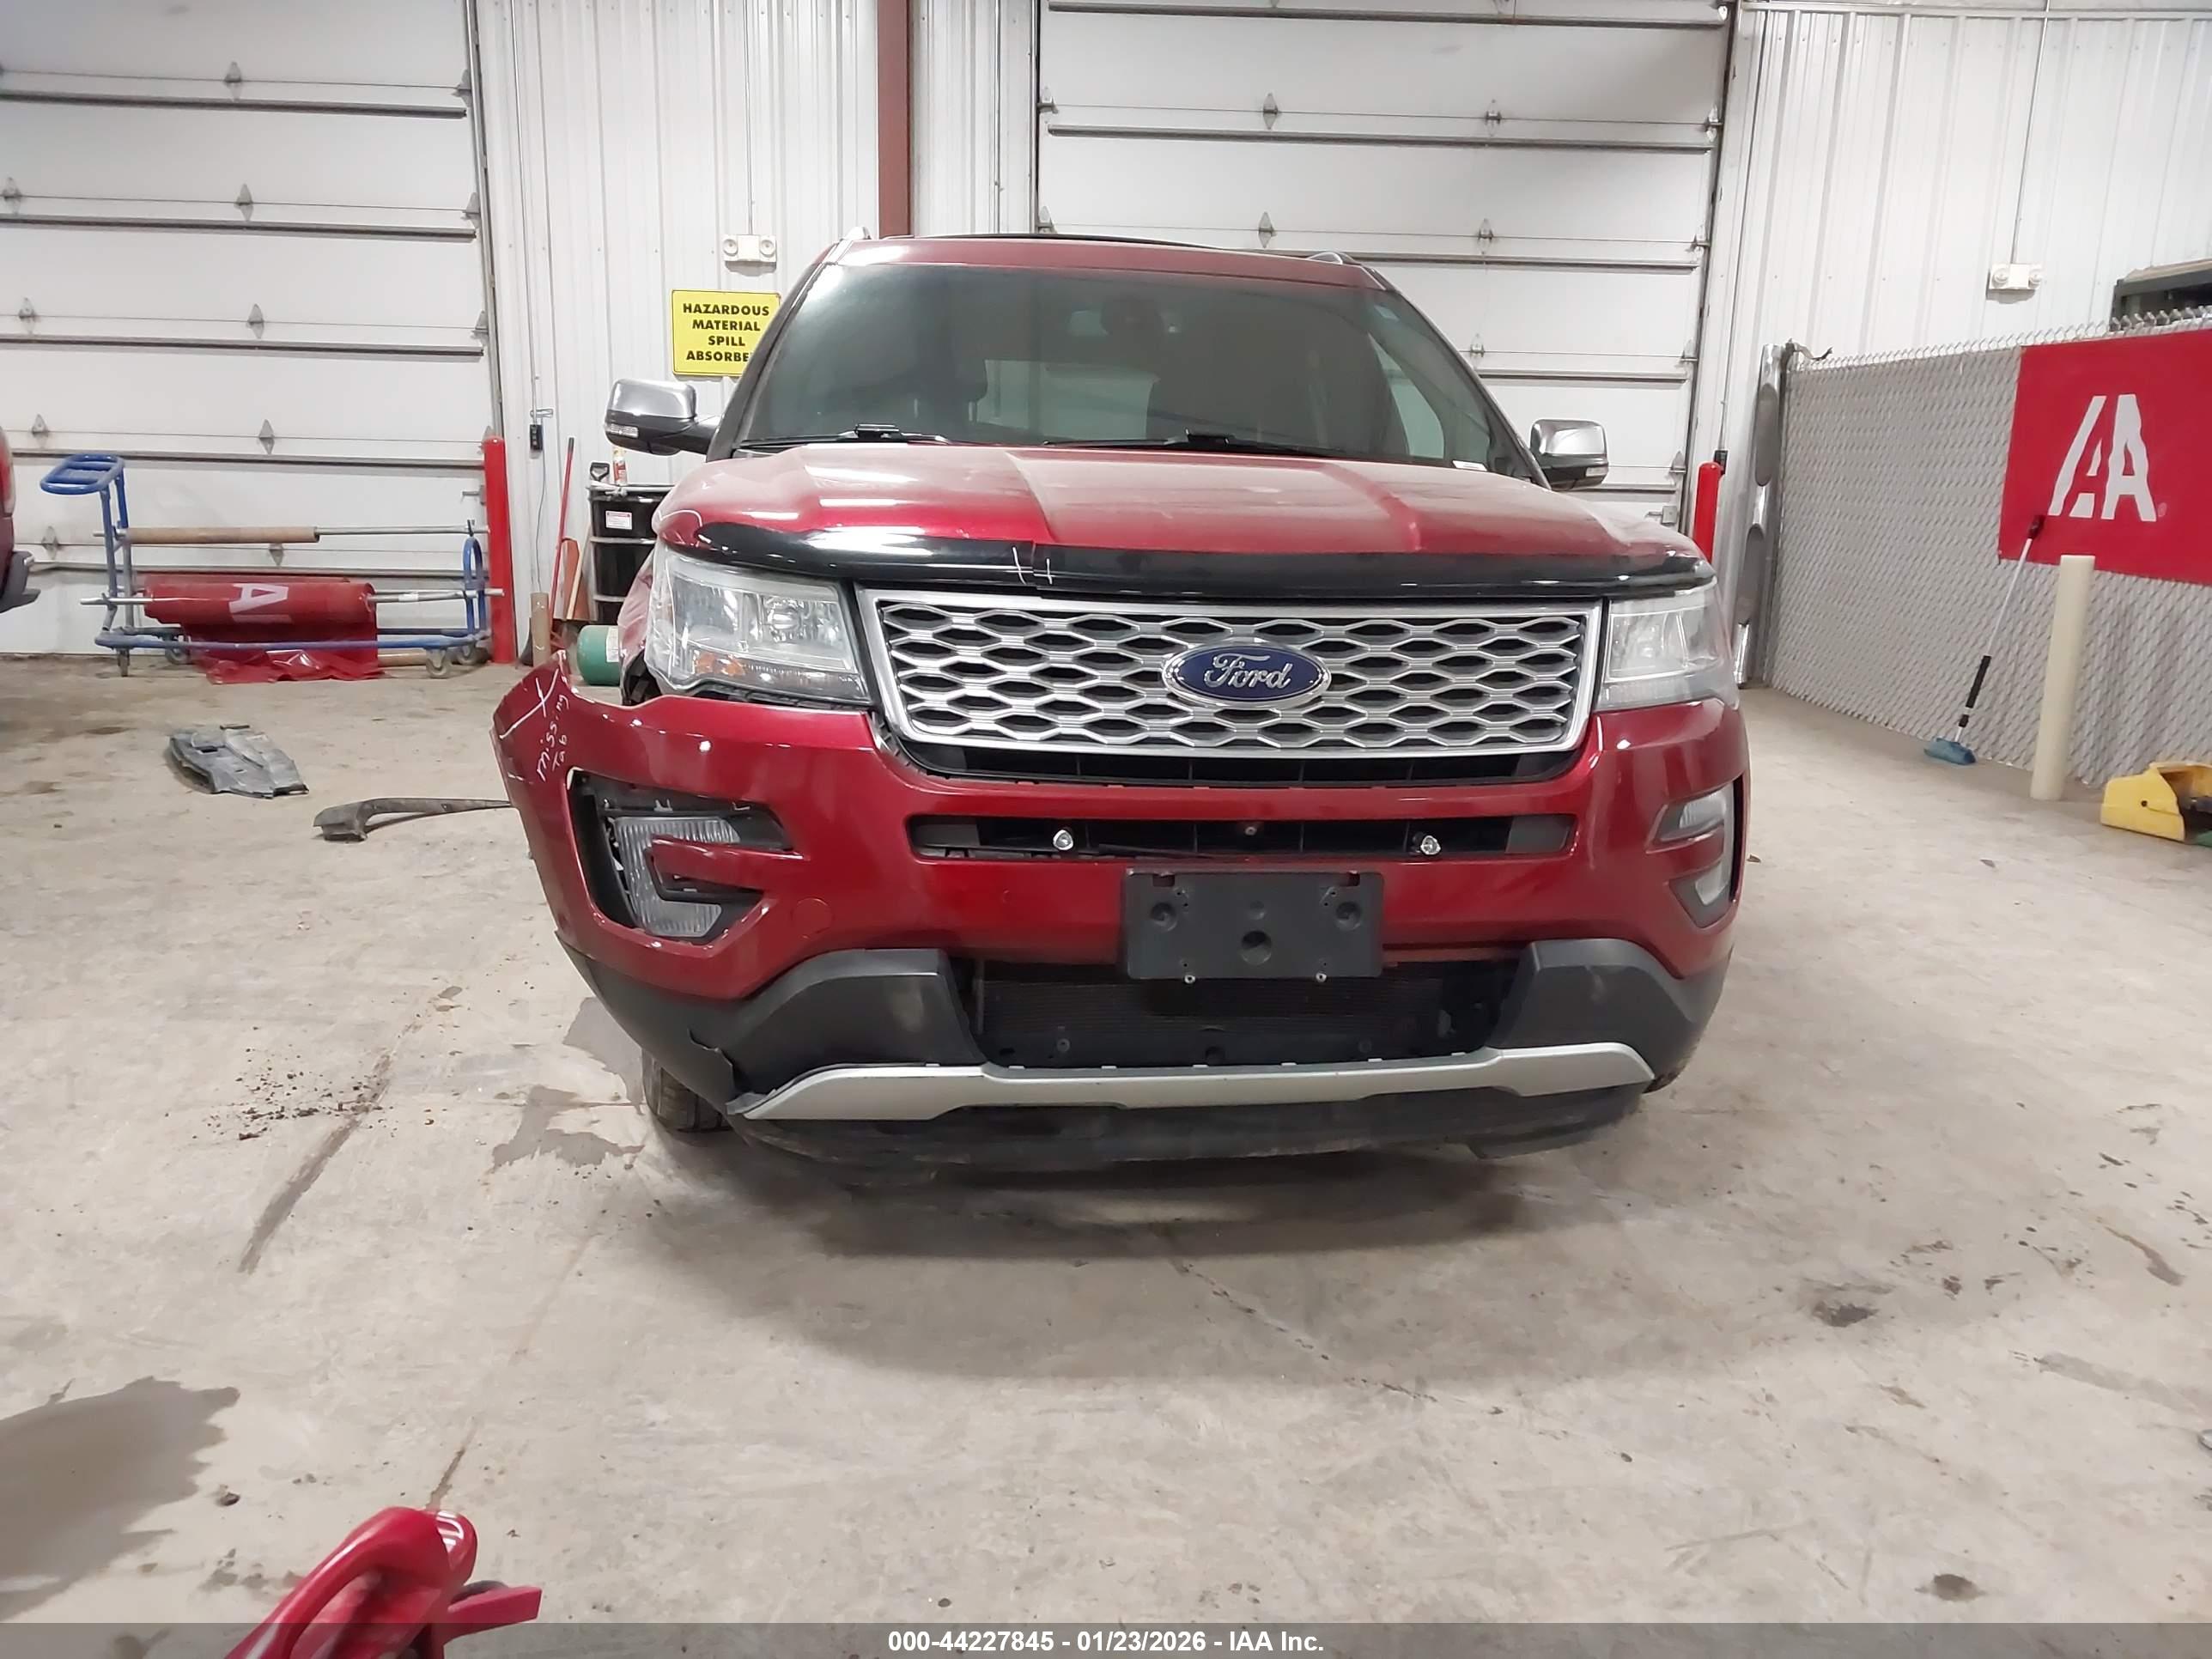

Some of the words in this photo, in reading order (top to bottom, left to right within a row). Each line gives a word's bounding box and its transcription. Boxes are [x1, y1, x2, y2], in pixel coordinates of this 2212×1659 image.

[683, 303, 769, 316] HAZARDOUS
[692, 319, 761, 331] MATERIAL
[708, 336, 745, 347] SPILL
[686, 350, 753, 362] ABSORBE
[1204, 653, 1292, 689] Ford
